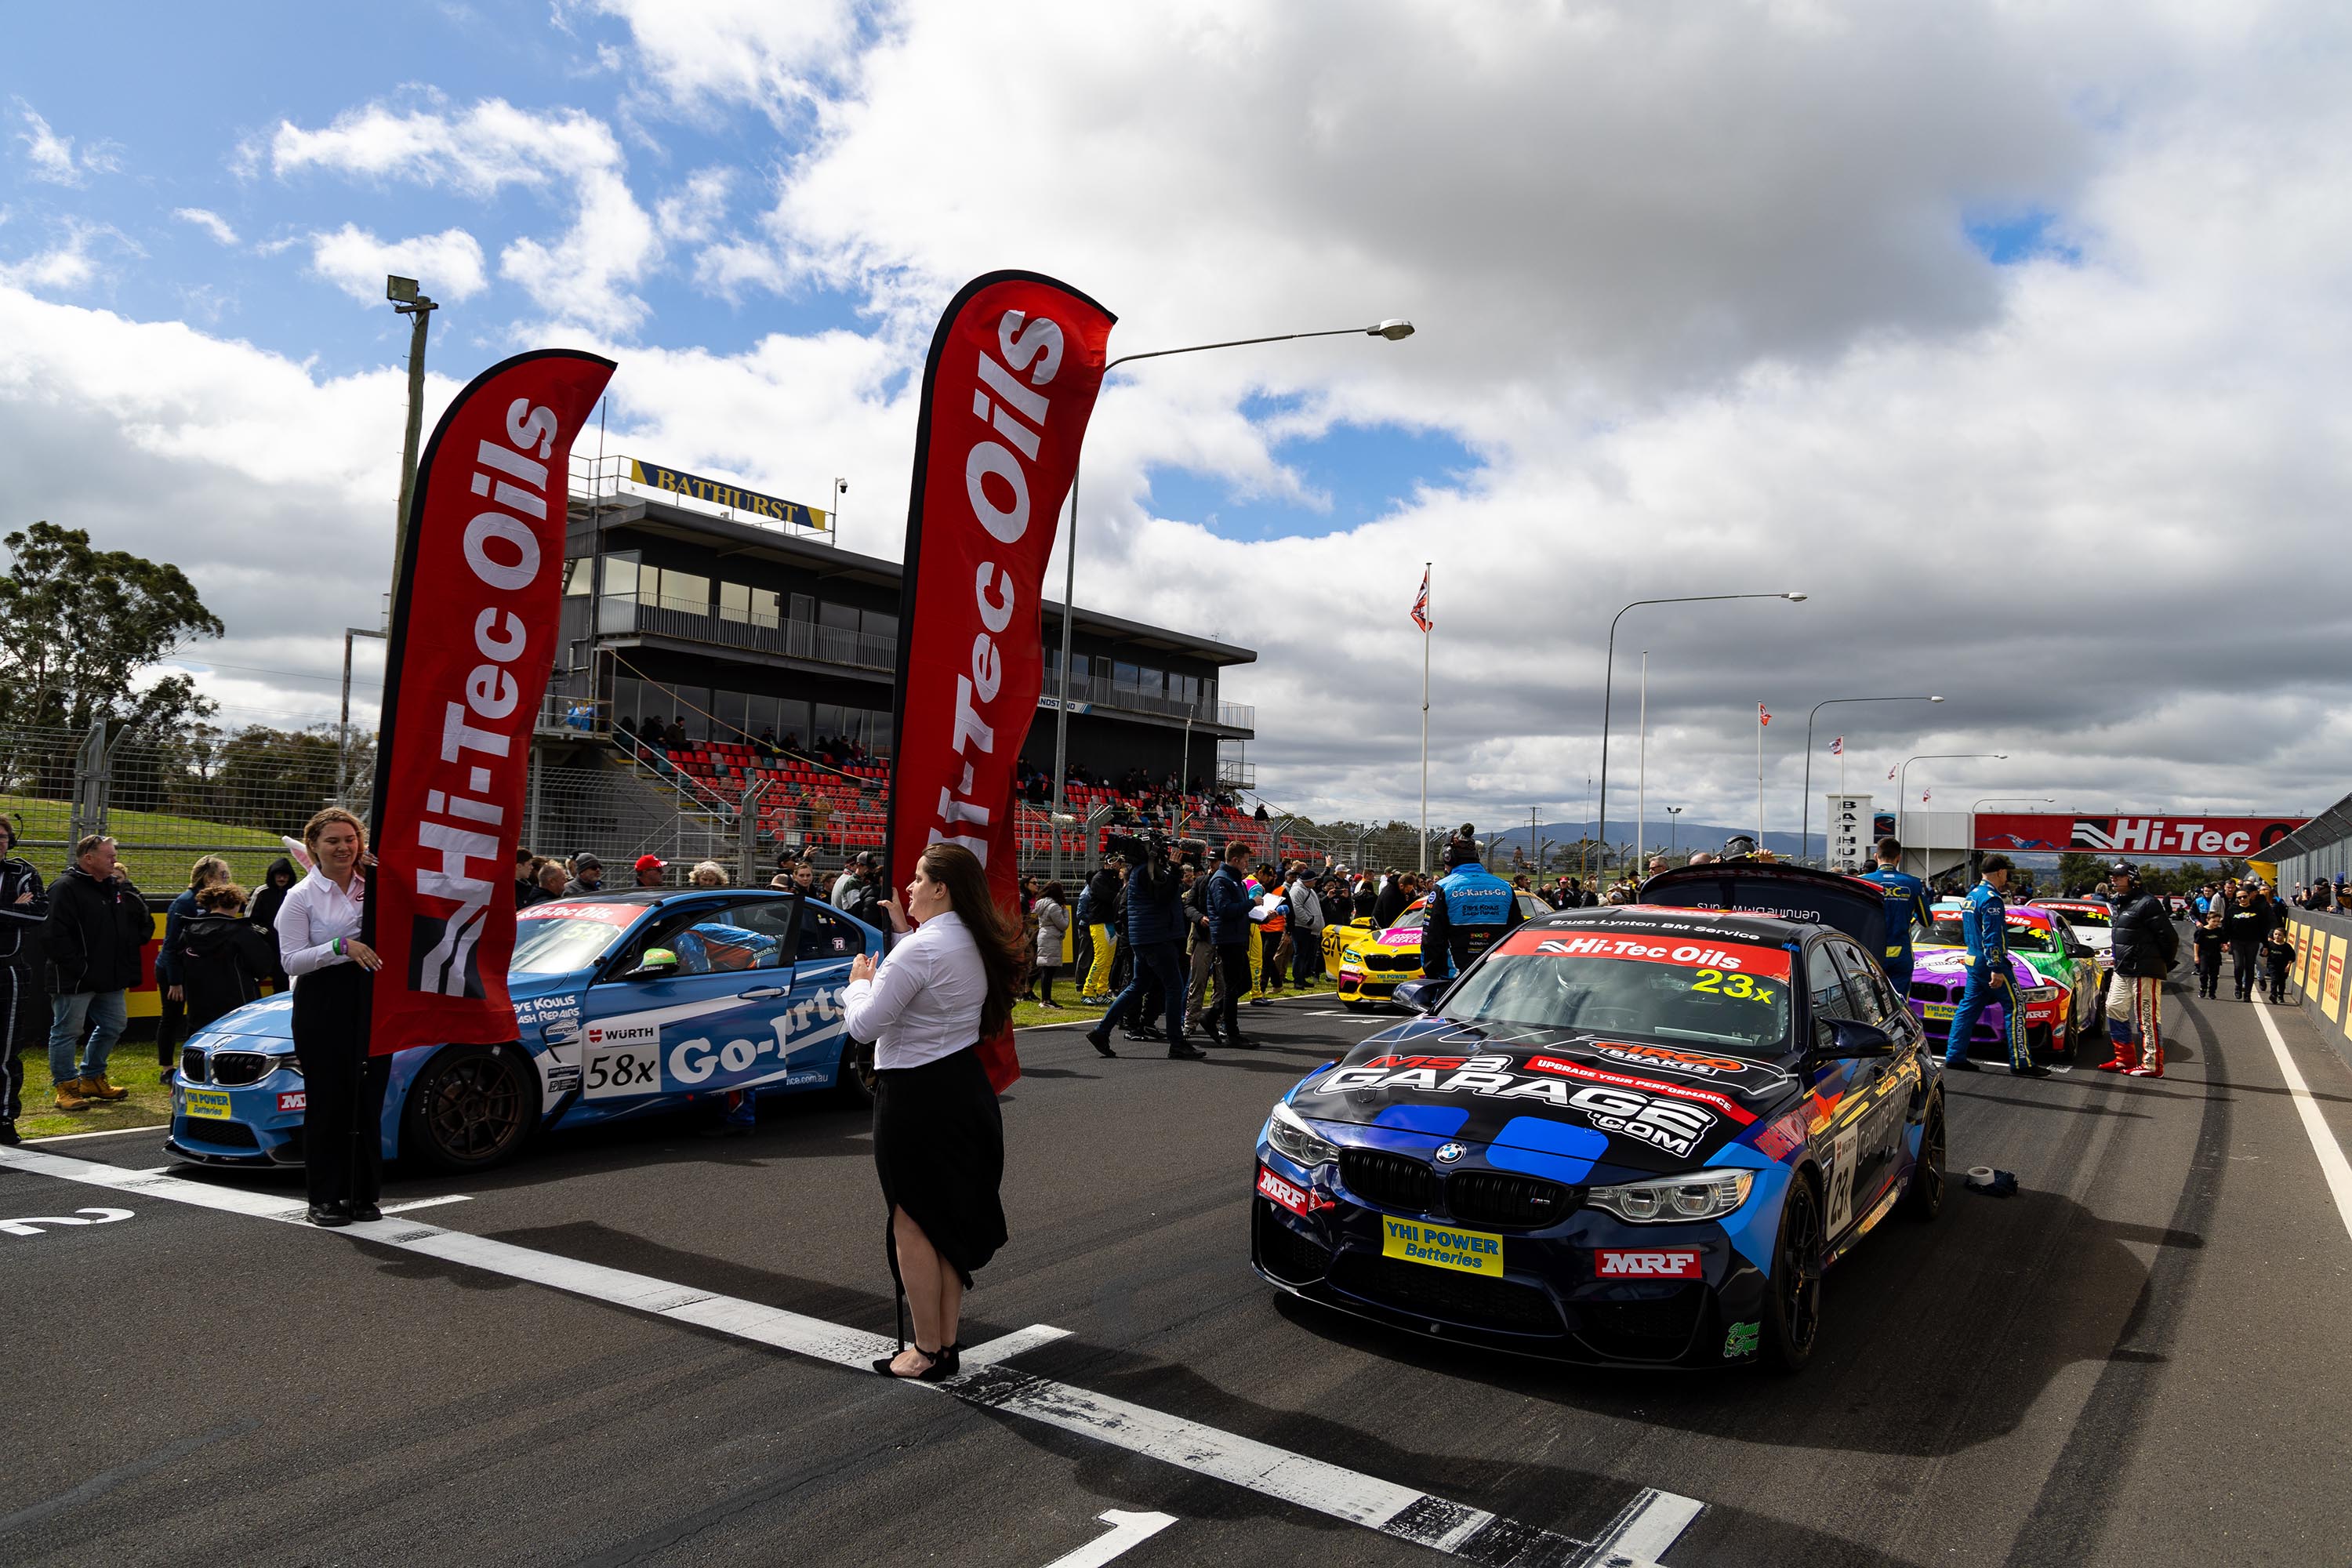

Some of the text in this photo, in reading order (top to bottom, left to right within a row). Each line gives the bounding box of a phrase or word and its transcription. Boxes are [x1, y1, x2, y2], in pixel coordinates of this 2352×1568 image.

[966, 310, 1064, 544] Oils
[657, 469, 798, 523] BATHURST
[416, 397, 557, 906] Hi-Tec Oils
[2114, 818, 2251, 852] Hi-Tec
[1451, 888, 1507, 898] Go-Karts-Go
[574, 906, 615, 920] Oils
[2086, 912, 2109, 921] 21x
[1599, 920, 1657, 929] Lynton
[1661, 922, 1690, 931] BM
[1694, 926, 1761, 941] Service
[2028, 928, 2051, 941] 4x
[1566, 938, 1742, 970] Hi-Tec Oils
[1691, 969, 1775, 1004] 23x
[513, 995, 575, 1013] EVE KOULIS
[517, 1007, 580, 1025] ASH REPAIRS
[605, 1027, 654, 1040] WÜRTH
[1595, 1041, 1742, 1070] CIRCO
[1607, 1048, 1711, 1073] BRAKES
[586, 1054, 656, 1089] 58x
[1537, 1059, 1732, 1112] UPGRADE YOUR PERFORMANCE
[198, 1093, 229, 1106] POWER
[1319, 1067, 1711, 1140] GARAGE
[1592, 1112, 1690, 1153] .COM
[1259, 1171, 1306, 1210] MRF
[1386, 1221, 1500, 1255] YHI POWER
[1404, 1243, 1483, 1269] Batteries
[1602, 1254, 1694, 1274] MRF
